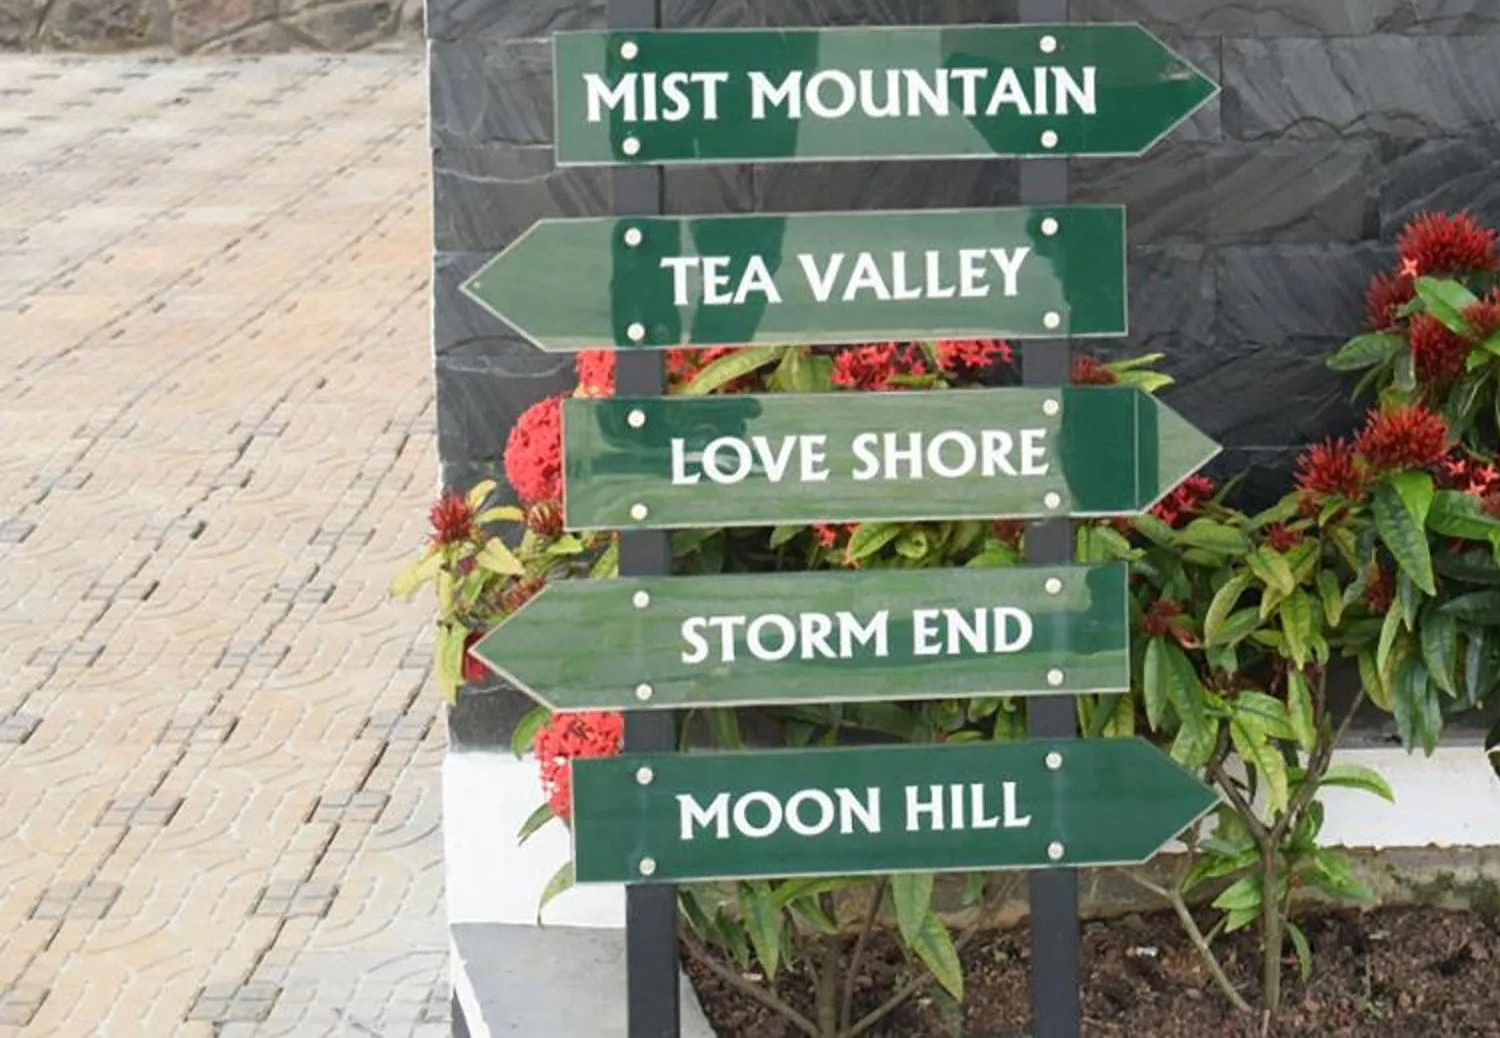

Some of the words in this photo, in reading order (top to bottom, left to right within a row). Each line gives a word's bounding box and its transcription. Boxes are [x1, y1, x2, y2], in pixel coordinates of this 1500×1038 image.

[582, 70, 729, 123] MIST
[748, 65, 1097, 119] MOUNTAIN
[660, 254, 782, 306] TEA
[797, 246, 1031, 302] VALLEY
[670, 434, 831, 486] LOVE
[851, 427, 1050, 481] SHORE
[680, 609, 890, 664] STORM
[911, 606, 1034, 656] END
[676, 788, 882, 840] MOON
[904, 781, 1031, 832] HILL
